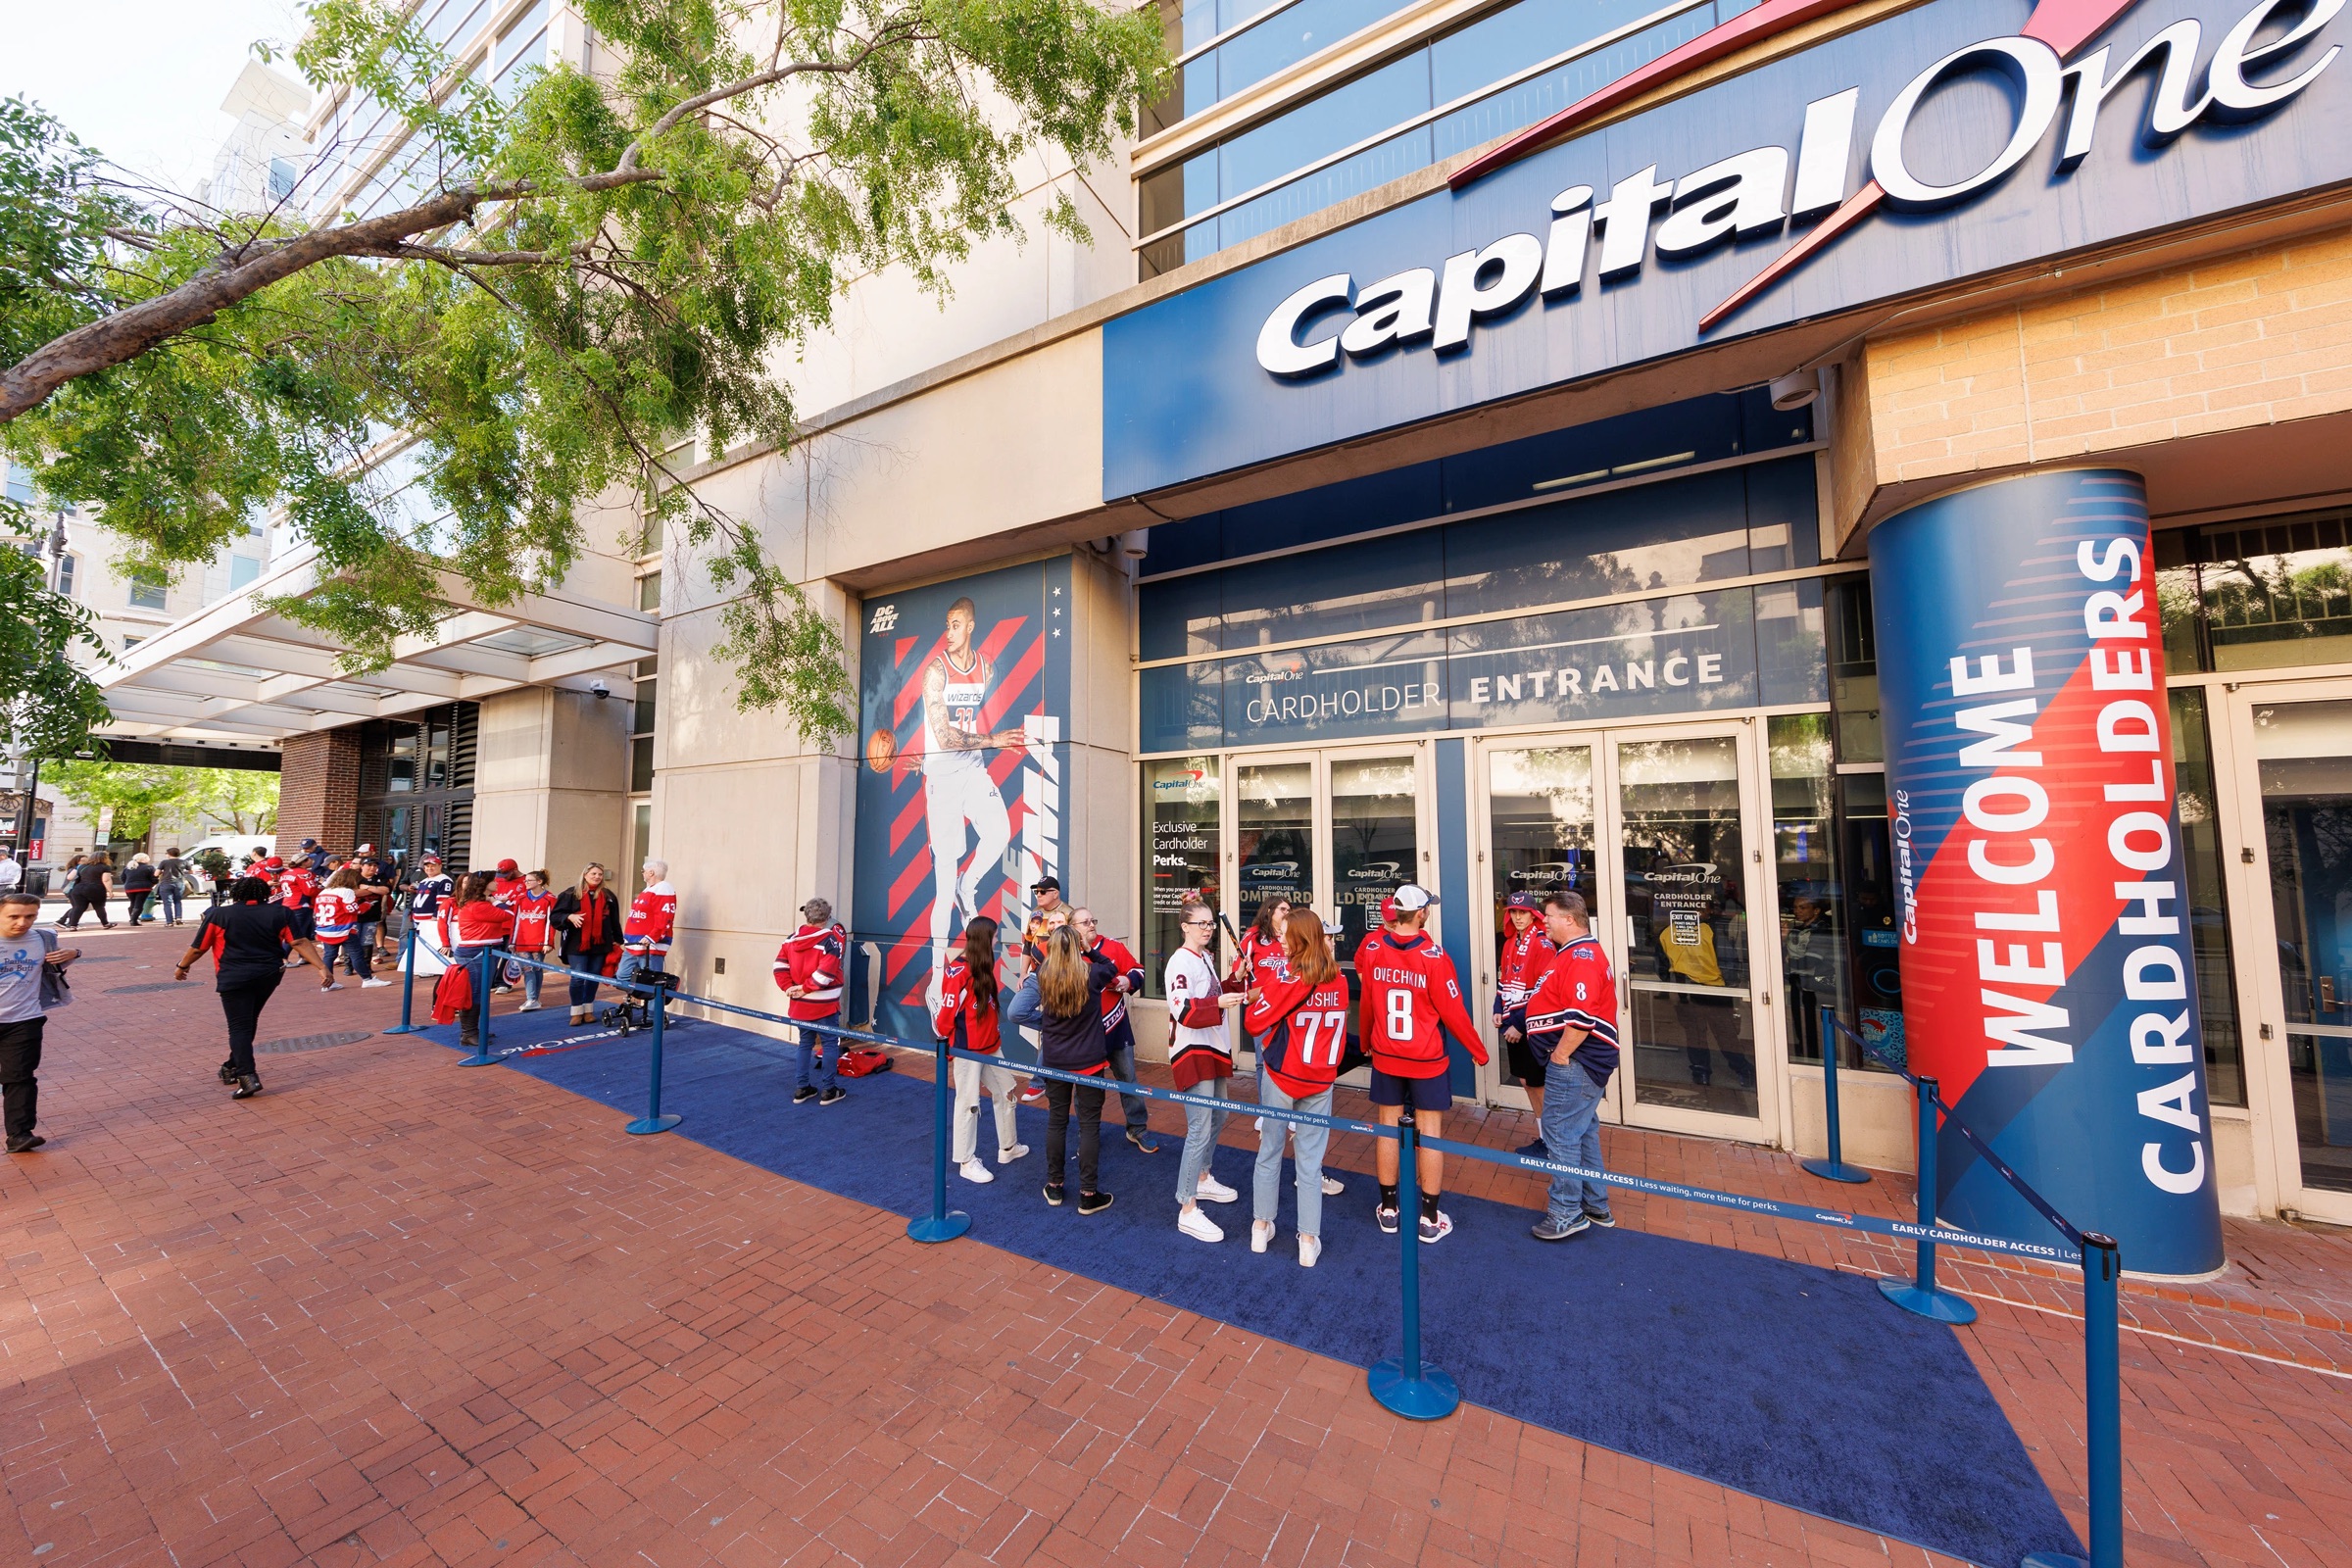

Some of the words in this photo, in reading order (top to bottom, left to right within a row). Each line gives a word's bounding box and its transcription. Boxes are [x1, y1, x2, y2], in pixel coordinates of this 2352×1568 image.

[870, 612, 899, 624] ABOVE
[874, 604, 895, 617] DC
[869, 619, 895, 634] ALL
[948, 692, 983, 703] wizards
[1247, 682, 1441, 723] CARDHOLDER
[1471, 654, 1724, 704] ENTRANCE
[1152, 820, 1197, 833] Exclusive
[1152, 837, 1208, 850] Cardholder
[1152, 854, 1188, 866] Perks.
[1950, 646, 2075, 1067] WELCOME
[2077, 536, 2206, 1195] CARDHOLDERS
[346, 902, 359, 913] 92
[414, 894, 429, 908] N
[662, 903, 676, 913] 43
[1373, 966, 1427, 989] OVECHKIN
[1446, 979, 1459, 999] 8
[1576, 982, 1587, 1001] 8
[1387, 988, 1413, 1041] 8
[1296, 1010, 1347, 1065] 77
[1010, 1062, 1037, 1072] CARDHOLDER
[1038, 1067, 1053, 1076] ACCESS
[1064, 1073, 1079, 1082] waiting,
[1169, 1093, 1185, 1102] EARLY
[1186, 1096, 1220, 1107] CARDHOLDER
[1221, 1102, 1241, 1110] ACCESS
[1256, 1107, 1276, 1117] waiting,
[1313, 1117, 1329, 1126] perks.
[1520, 1157, 1545, 1168] EARLY
[1546, 1162, 1601, 1179] CARDHOLDER
[1602, 1173, 1635, 1186] ACCESS
[1640, 1180, 1658, 1190] Less
[1659, 1185, 1691, 1197] waiting,
[1693, 1191, 1715, 1200] more
[1717, 1194, 1737, 1204] time
[1739, 1197, 1750, 1206] for
[1752, 1200, 1780, 1212] perks.
[1892, 1223, 1927, 1237] EARLY
[1930, 1229, 2007, 1249] CARDHOLDER
[2010, 1242, 2056, 1255] ACCESS
